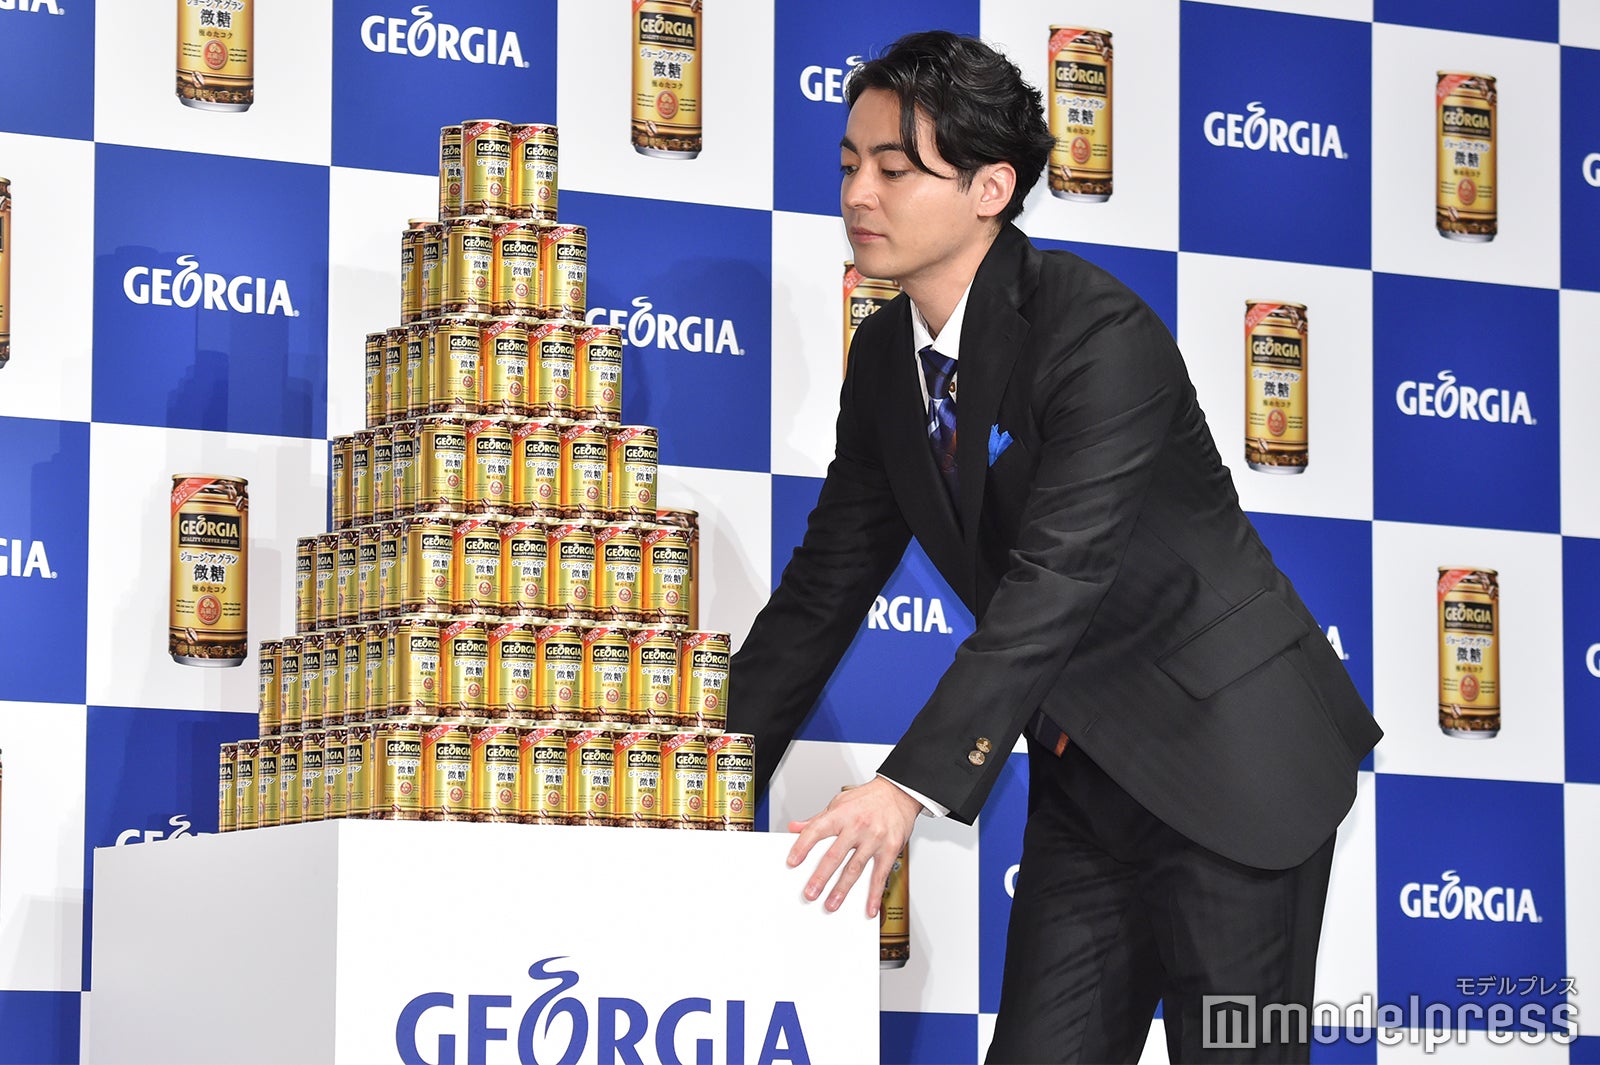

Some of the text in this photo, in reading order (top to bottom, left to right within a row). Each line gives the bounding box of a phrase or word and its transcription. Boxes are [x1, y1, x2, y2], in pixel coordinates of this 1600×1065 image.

[201, 9, 231, 28] 微糖
[640, 14, 694, 37] GEORGIA
[361, 5, 524, 68] GEORGIA
[653, 61, 681, 79] 微糖
[800, 55, 865, 104] GE
[1056, 63, 1105, 85] GEORGIA
[1203, 101, 1344, 159] GEORGIA
[1443, 108, 1490, 129] GEORGIA
[123, 255, 294, 317] GEORGIA
[1253, 337, 1300, 358] GEORGIA
[1396, 370, 1533, 425] GEORGIA
[181, 515, 238, 538] GEORGIA
[193, 563, 226, 583] 微糖
[1445, 603, 1492, 624] GEORGIA
[1400, 870, 1538, 923] GEORGIA
